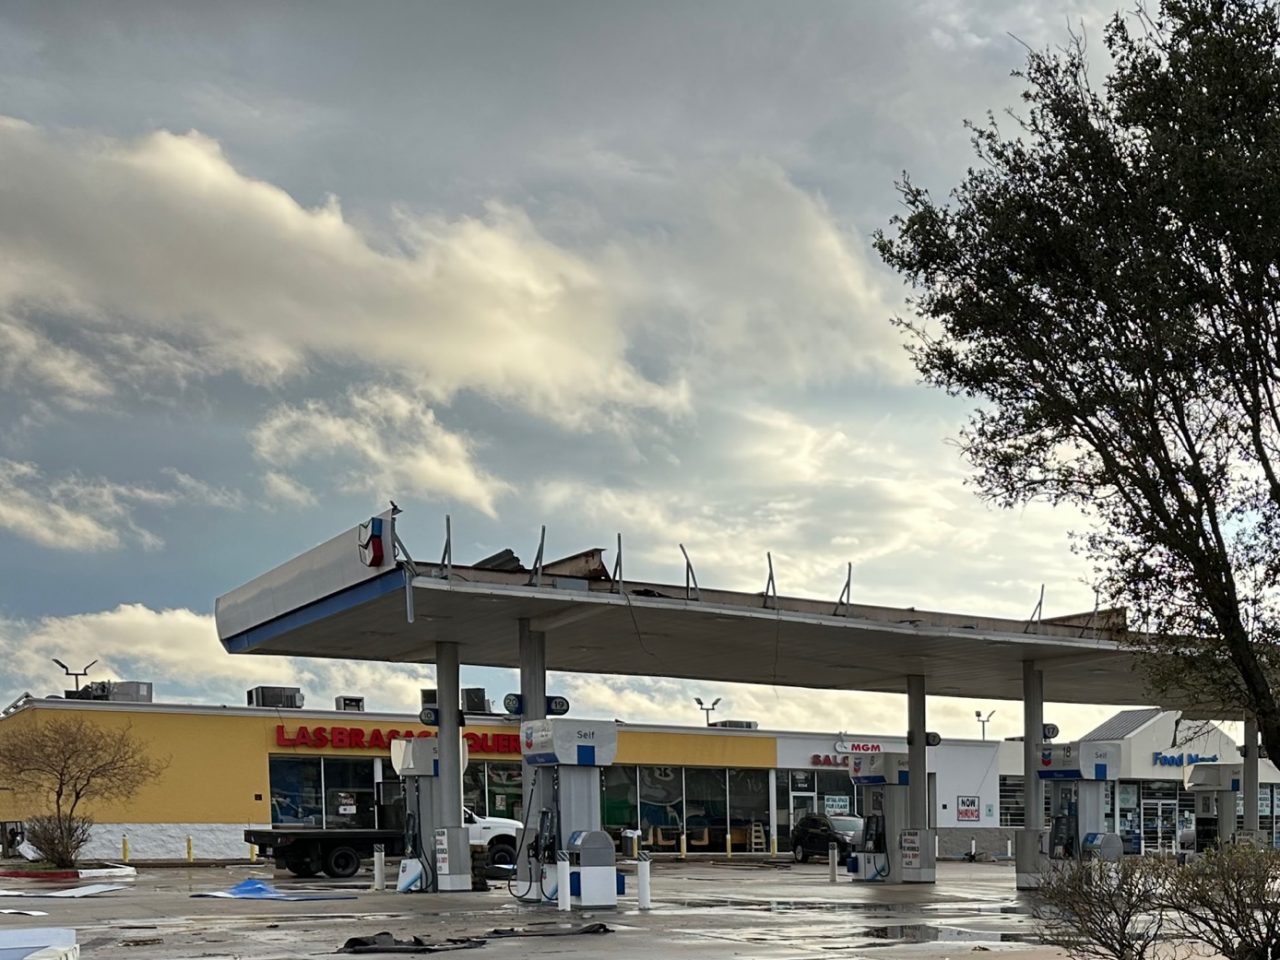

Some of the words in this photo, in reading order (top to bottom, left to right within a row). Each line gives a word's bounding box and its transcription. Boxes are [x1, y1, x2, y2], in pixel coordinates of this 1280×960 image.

[507, 697, 517, 706] 20
[555, 700, 564, 708] 19
[577, 730, 594, 739] Self
[1047, 727, 1055, 735] 17
[1064, 746, 1071, 758] 18
[1152, 751, 1184, 767] Food
[961, 798, 976, 807] NOW
